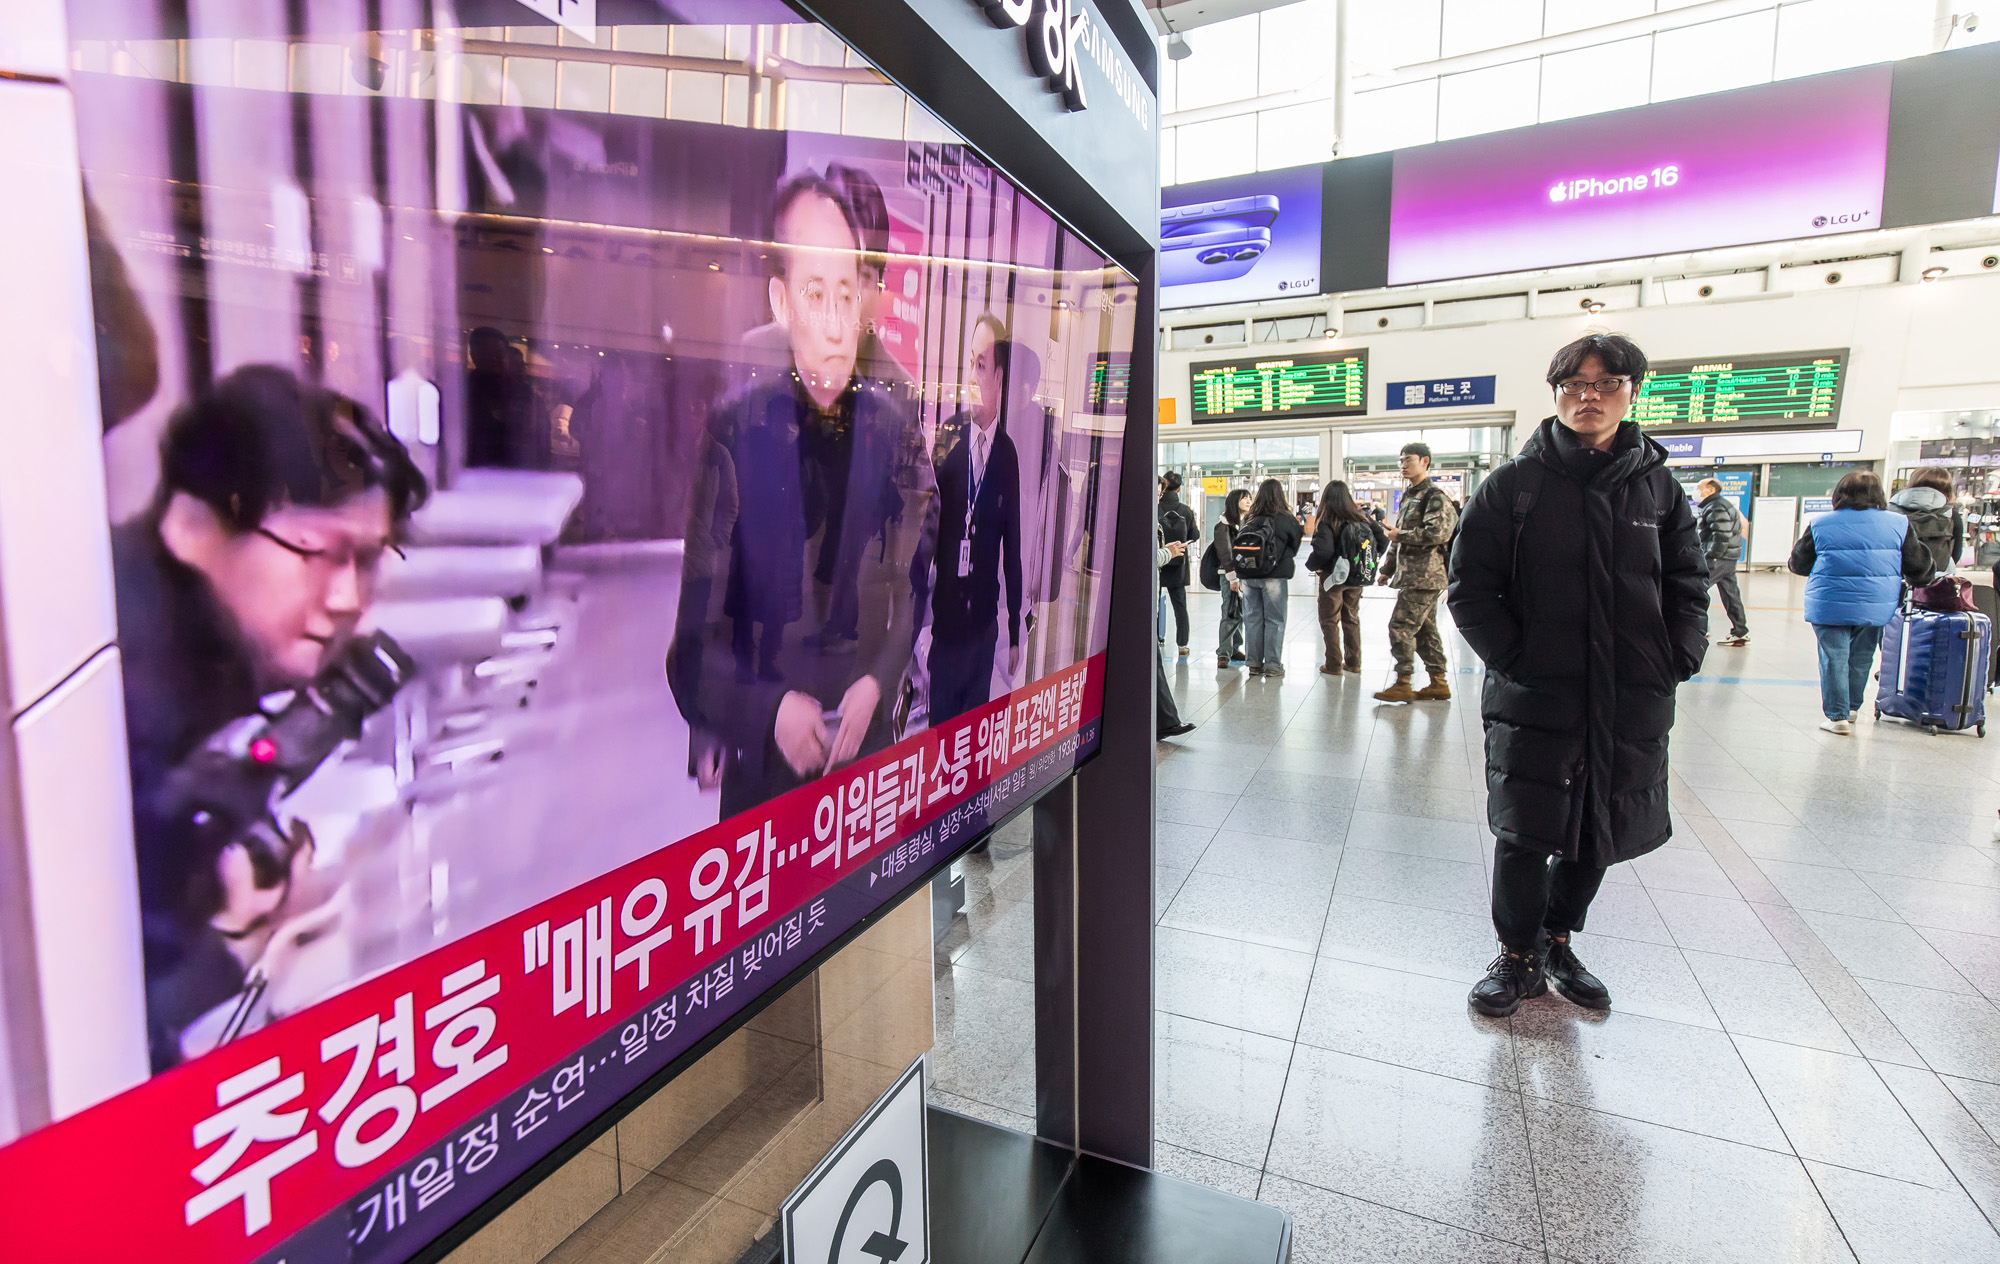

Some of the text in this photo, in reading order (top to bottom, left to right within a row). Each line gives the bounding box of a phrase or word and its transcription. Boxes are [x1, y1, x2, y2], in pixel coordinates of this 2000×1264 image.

[1081, 6, 1149, 131] SAMSUNG
[1568, 165, 1679, 200] iPhone 16
[1831, 214, 1848, 225] LG
[1290, 281, 1302, 289] LG
[1691, 363, 1733, 373] ARRIVALS
[1433, 382, 1454, 395] 타는
[1460, 381, 1471, 394] 곳
[185, 959, 508, 1236] 추경호
[523, 877, 672, 1018] "매우
[928, 725, 972, 804] 소통
[975, 704, 1012, 780] 위해
[1011, 683, 1057, 755] 표결엔
[347, 1113, 499, 1244] 개일정
[685, 957, 734, 1015] 차질
[743, 915, 803, 981] 빚어질
[807, 898, 826, 935] 듯
